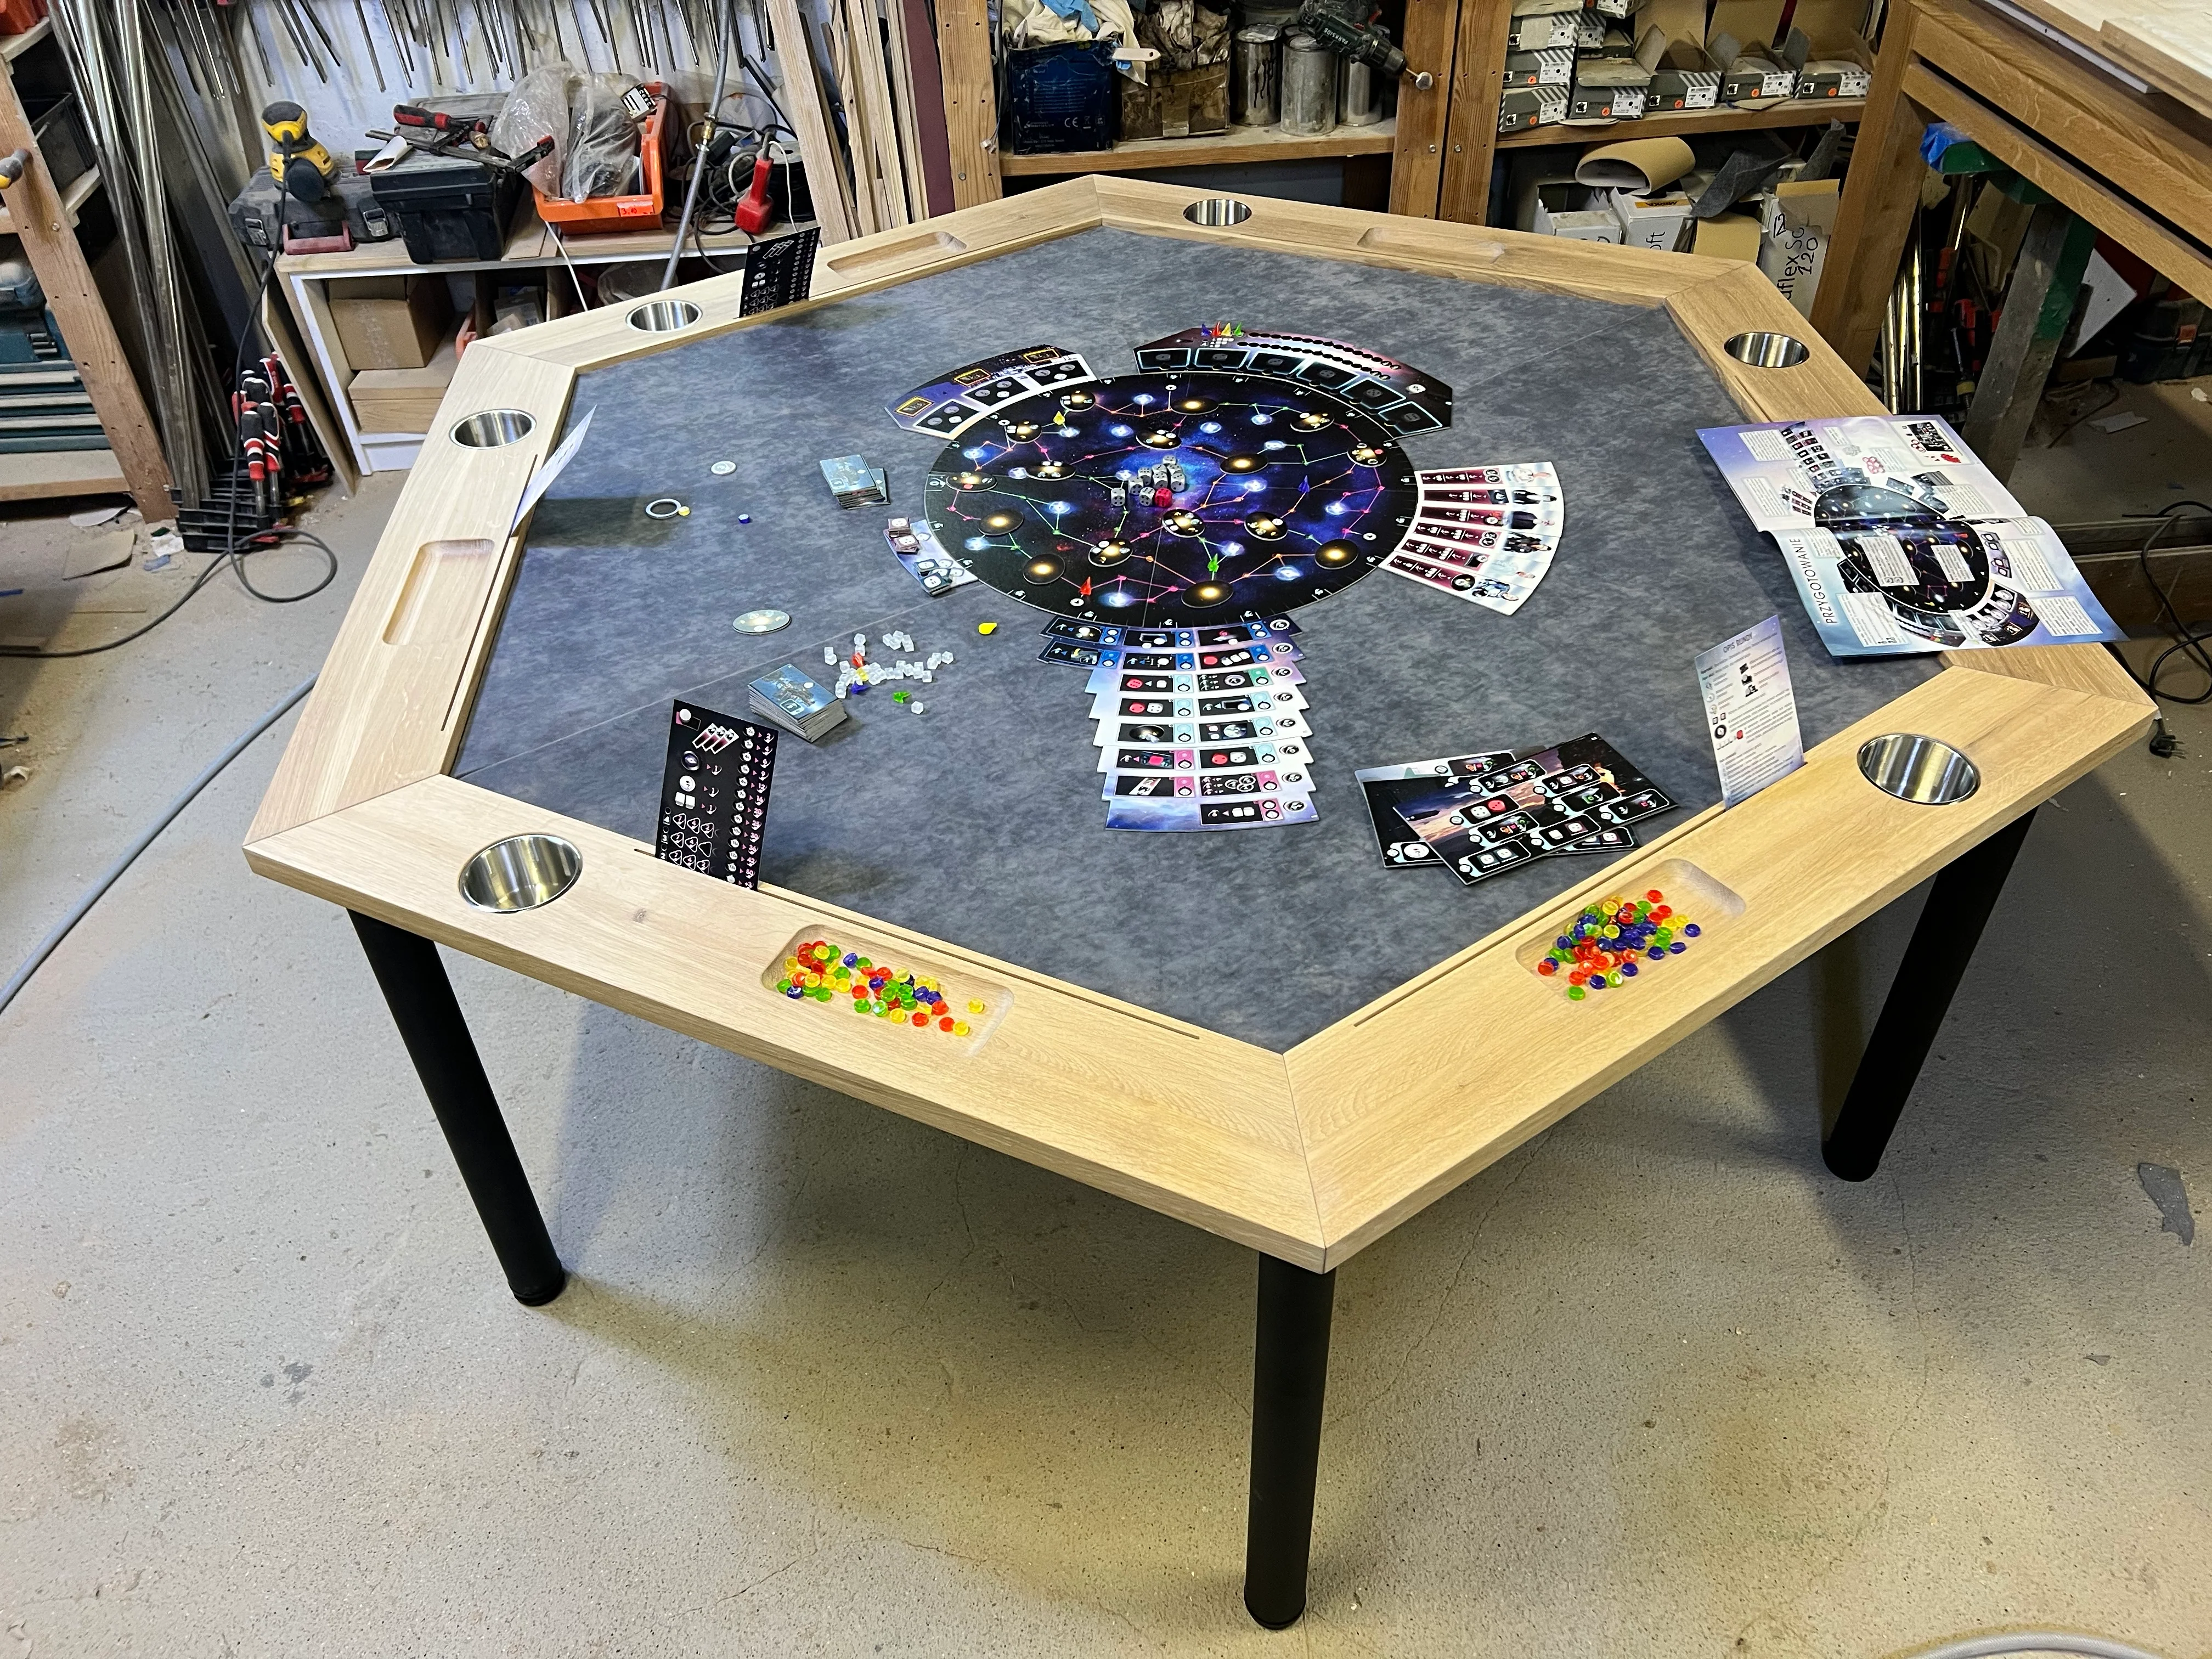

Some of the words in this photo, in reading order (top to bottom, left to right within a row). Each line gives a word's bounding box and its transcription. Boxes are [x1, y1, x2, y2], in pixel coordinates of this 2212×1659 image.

[1323, 27, 1349, 45] PARKSIDE
[1797, 237, 1819, 275] 120
[1789, 538, 1838, 624] PRZYGOTOWANIE
